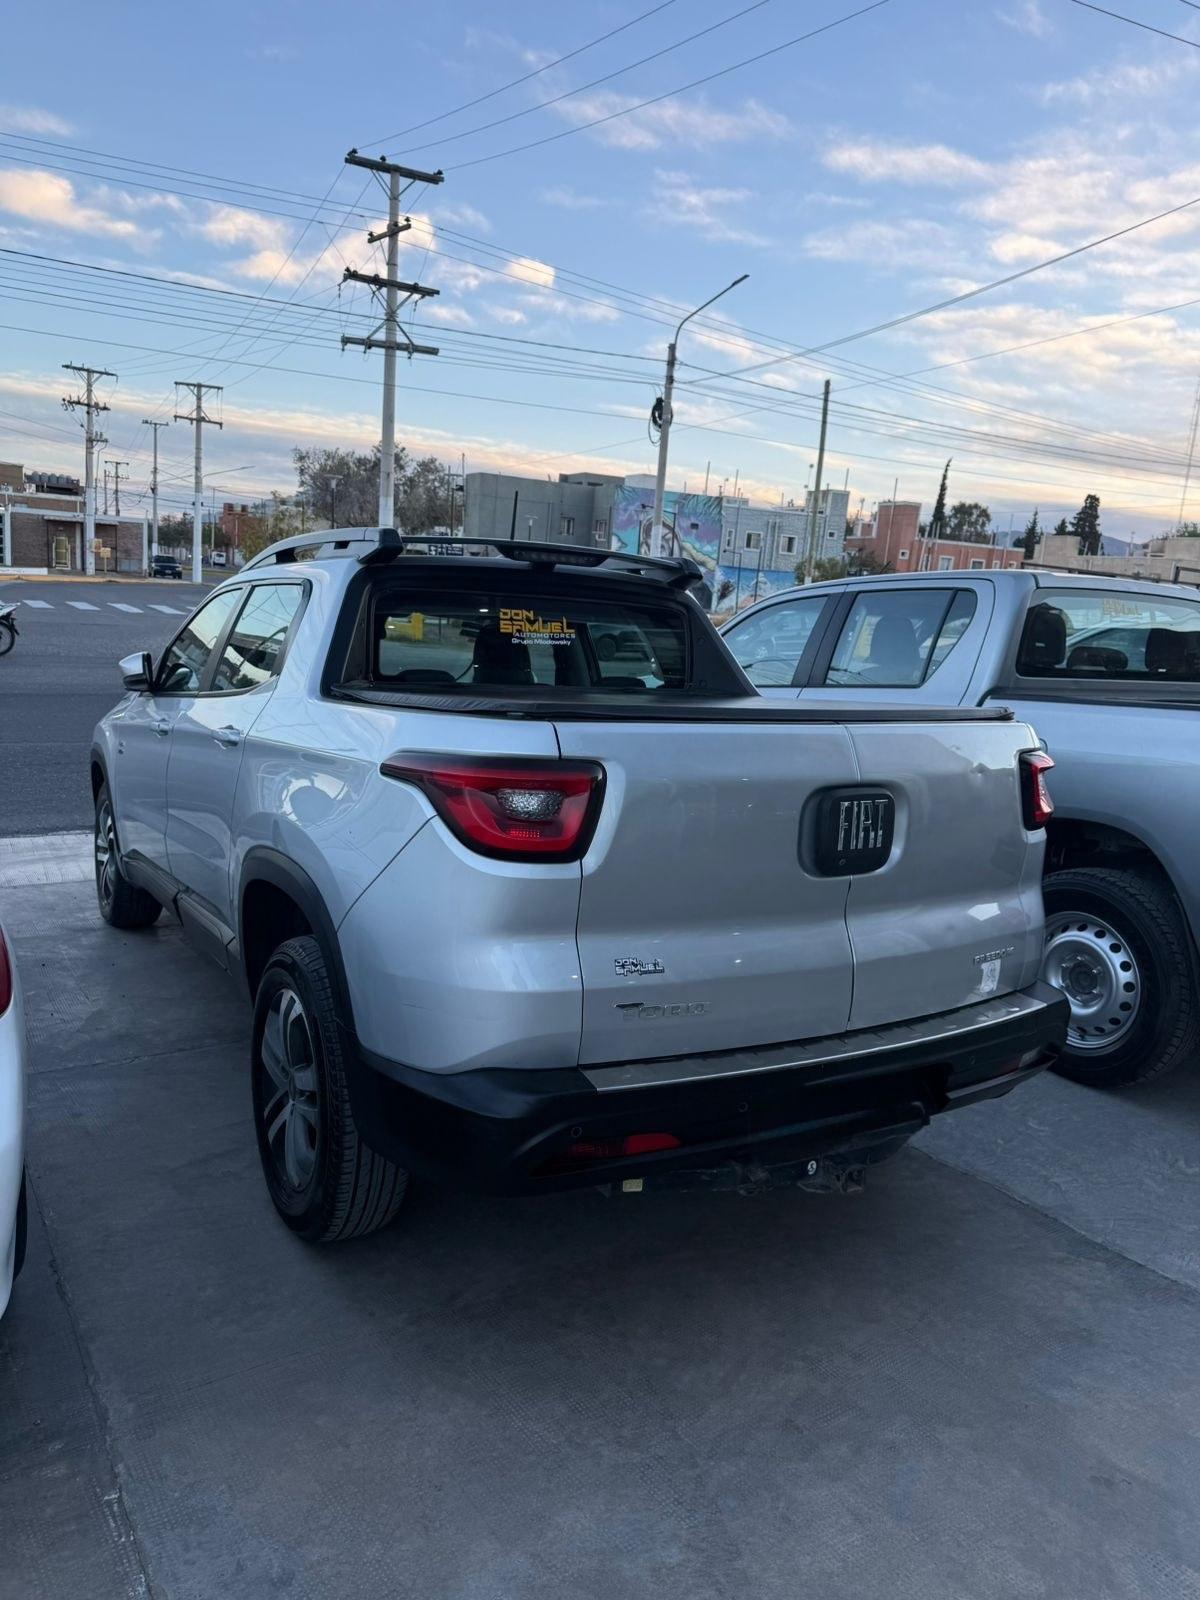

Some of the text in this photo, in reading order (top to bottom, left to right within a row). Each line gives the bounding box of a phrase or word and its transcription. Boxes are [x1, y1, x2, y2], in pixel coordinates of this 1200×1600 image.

[499, 609, 534, 620] DON
[499, 616, 576, 634] SAMUEL
[837, 799, 889, 851] FIAT
[615, 958, 637, 966] DON
[615, 959, 664, 976] SAMUEL
